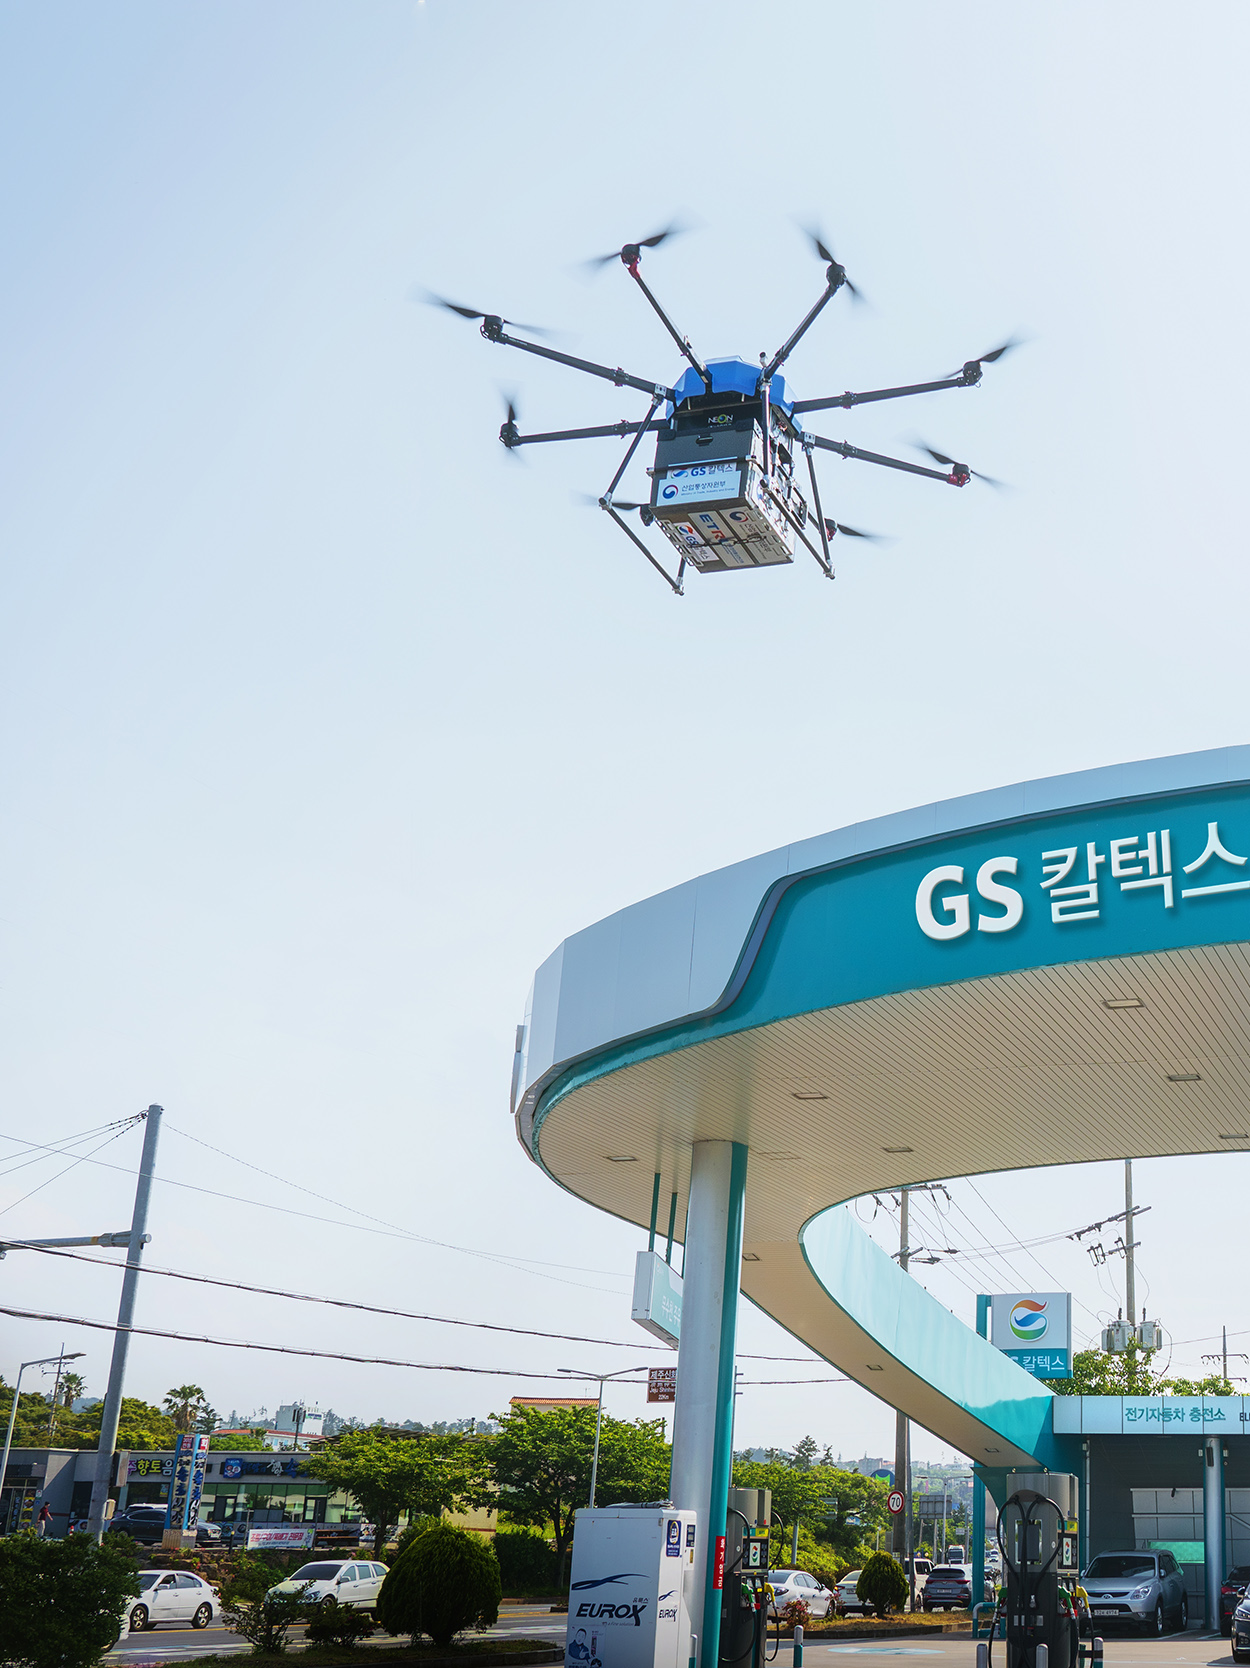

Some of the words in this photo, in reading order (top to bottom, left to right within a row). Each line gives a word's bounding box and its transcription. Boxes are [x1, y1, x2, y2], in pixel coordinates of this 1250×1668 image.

[708, 414, 733, 424] NEON
[691, 466, 706, 477] GS
[915, 856, 1024, 942] GS
[1022, 1355, 1065, 1372] 칼텍스
[1125, 1407, 1186, 1423] 전기자동차
[1189, 1407, 1226, 1422] 충전소
[891, 1497, 901, 1508] 70
[576, 1602, 648, 1627] EUROX
[658, 1609, 678, 1622] EUROX
